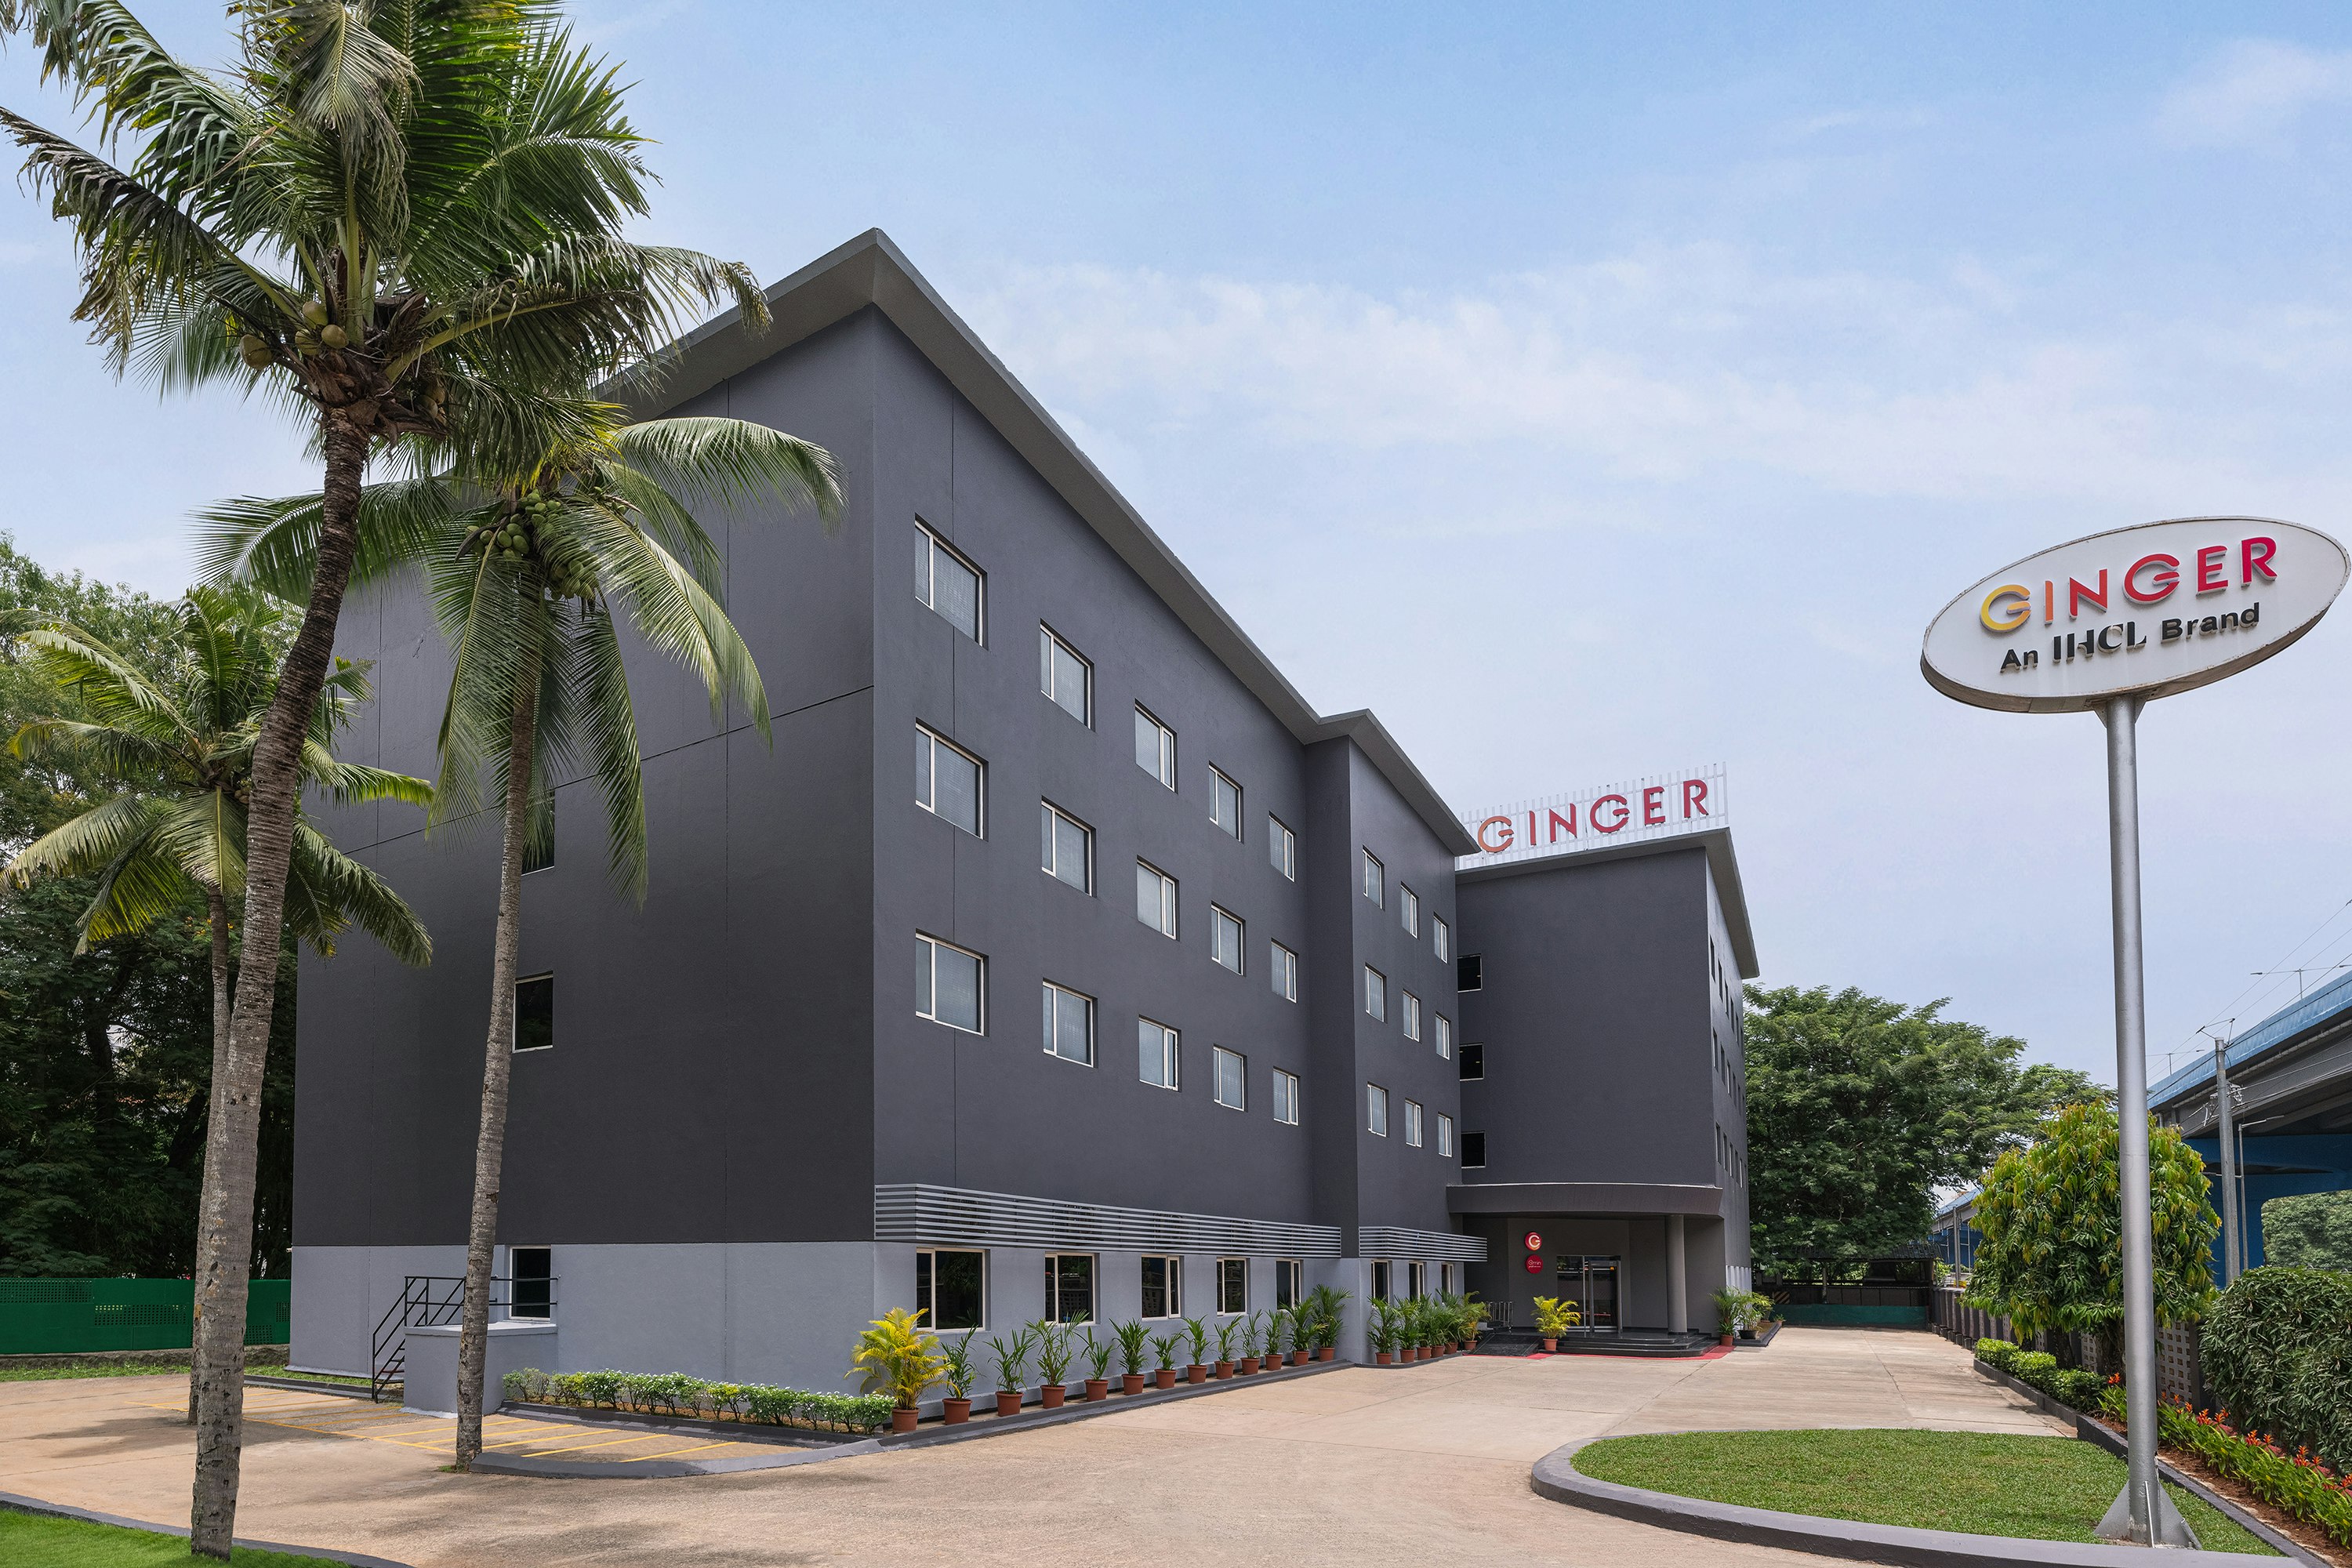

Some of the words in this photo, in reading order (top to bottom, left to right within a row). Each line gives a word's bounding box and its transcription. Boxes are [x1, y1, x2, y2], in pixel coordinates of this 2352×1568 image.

[1980, 537, 2278, 633] GINGER
[2000, 648, 2039, 673] An
[2053, 621, 2147, 662] IHCL
[2161, 602, 2260, 643] Brand
[1478, 779, 1709, 853] GINGER
